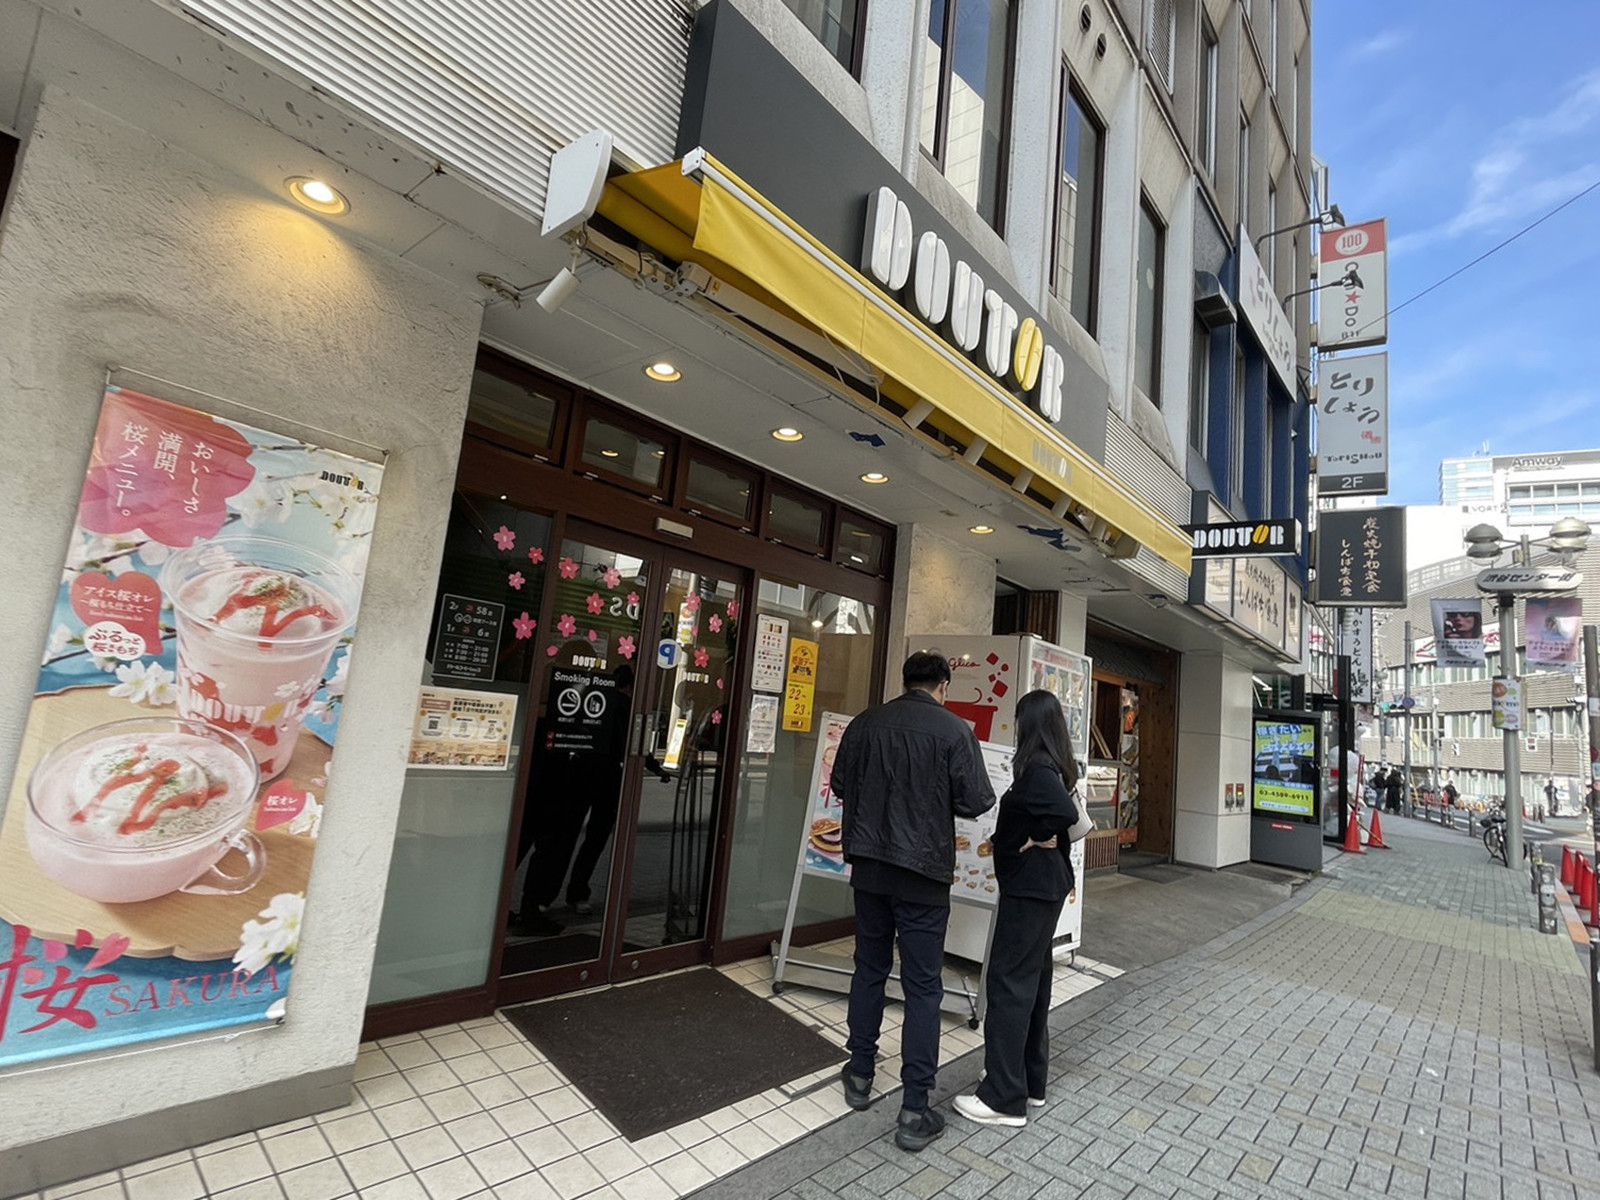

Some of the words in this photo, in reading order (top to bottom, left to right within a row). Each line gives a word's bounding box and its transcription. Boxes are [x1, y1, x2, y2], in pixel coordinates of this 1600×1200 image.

[1341, 232, 1362, 249] 100
[864, 186, 1065, 423] DOUTOR
[1330, 372, 1374, 397] とり
[1323, 397, 1380, 424] しょう
[153, 429, 183, 481] 満開、
[1511, 456, 1562, 468] Amway
[114, 421, 149, 517] 桜メニュー。
[184, 441, 214, 515] おいしさ
[321, 470, 364, 491] DOUTOR
[1341, 476, 1363, 489] 2F
[1194, 524, 1285, 549] DOUTOR
[83, 585, 154, 603] アイス桜オレ
[572, 654, 607, 670] DOUTOR
[948, 657, 981, 671] Glico
[554, 671, 591, 686] Smoking
[592, 676, 616, 687] Room
[267, 795, 298, 807] 桜オレ
[104, 964, 280, 1017] SAKURA
